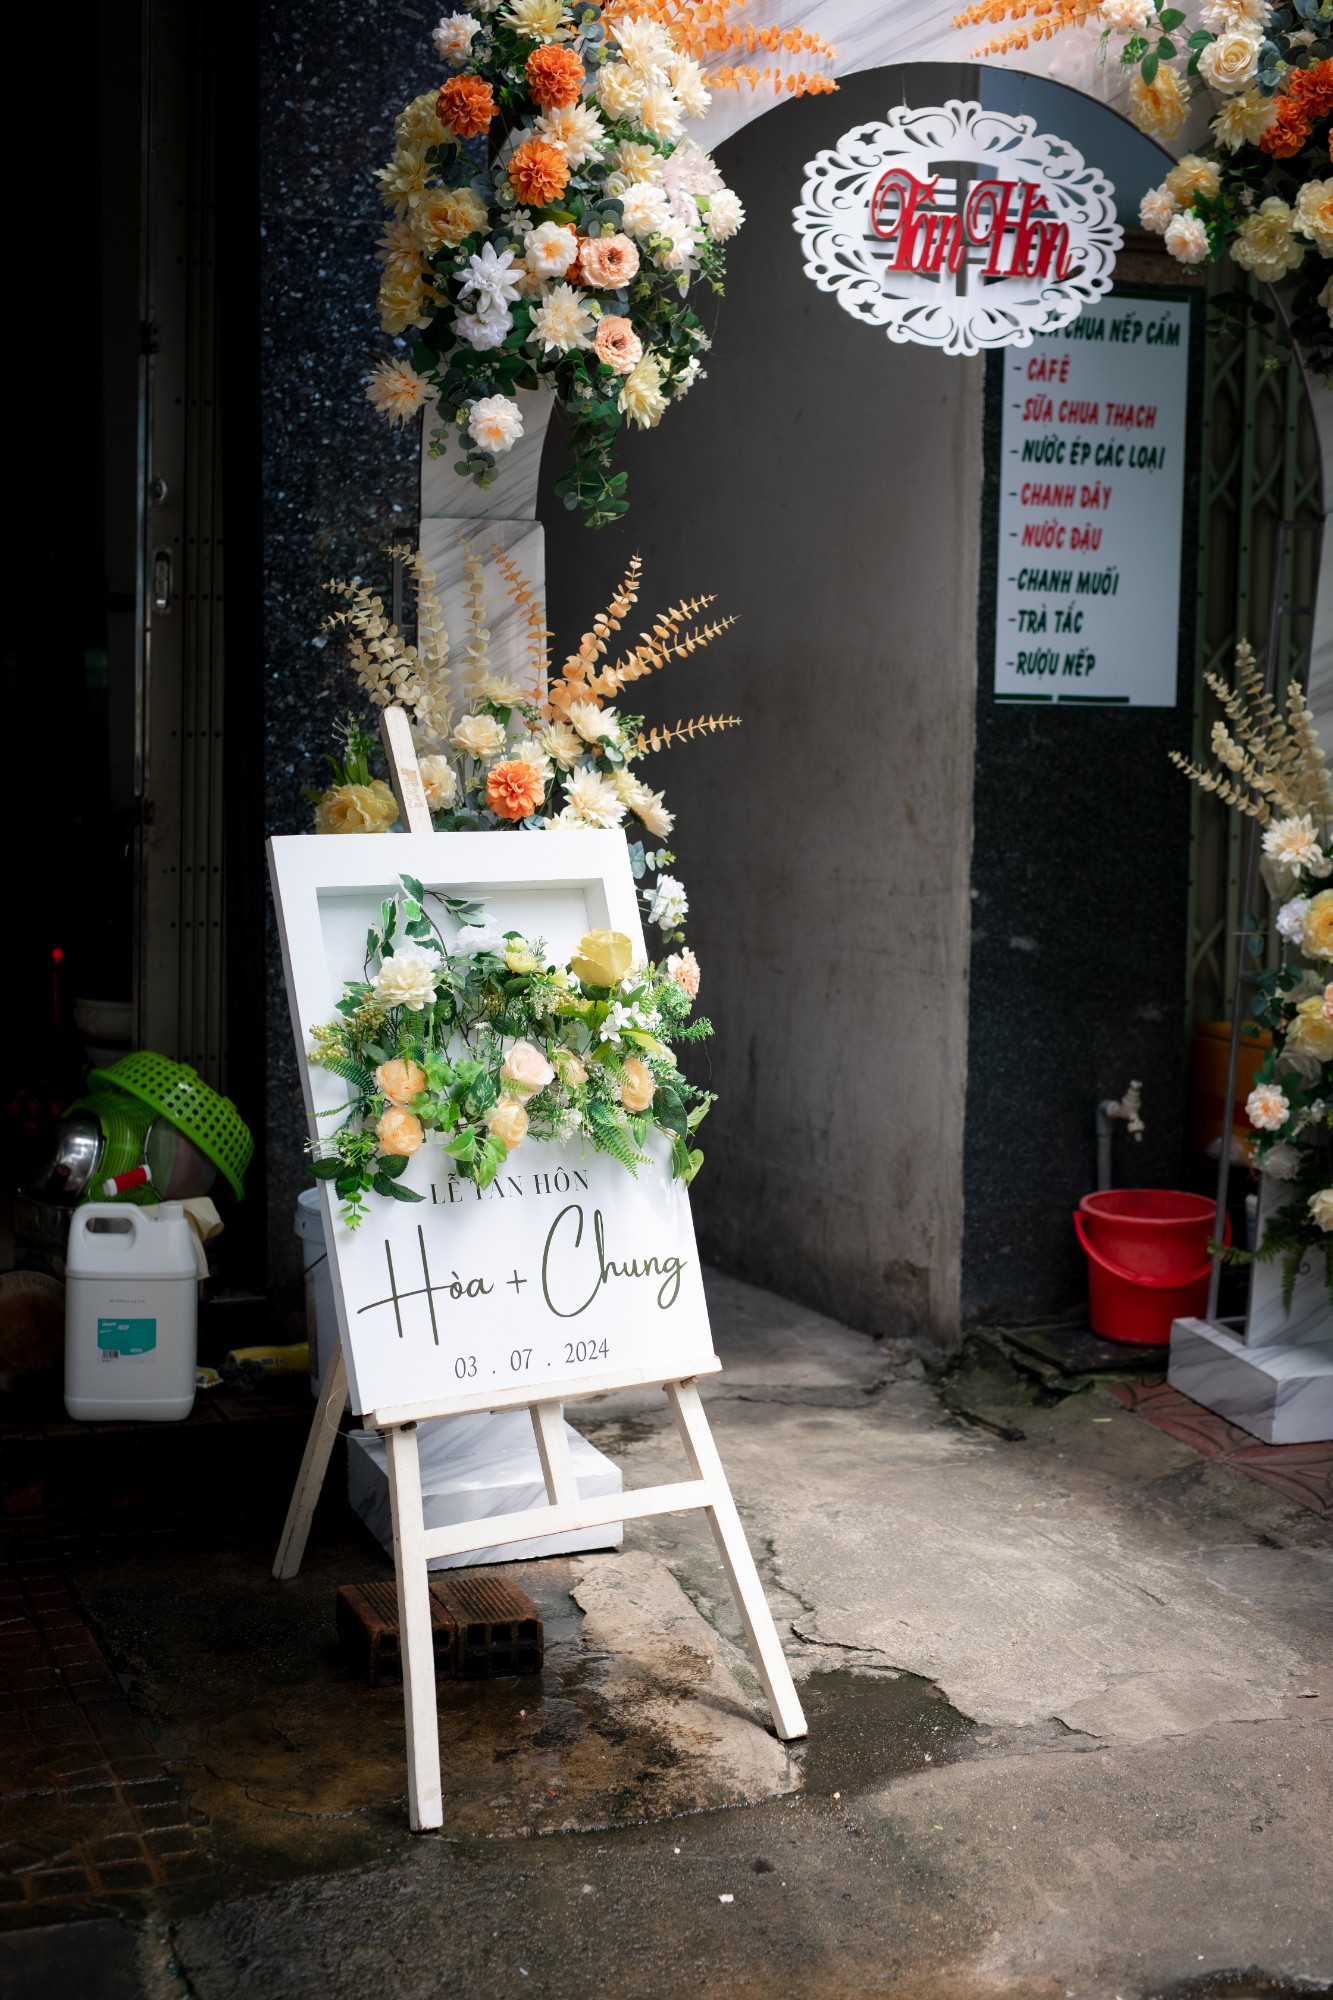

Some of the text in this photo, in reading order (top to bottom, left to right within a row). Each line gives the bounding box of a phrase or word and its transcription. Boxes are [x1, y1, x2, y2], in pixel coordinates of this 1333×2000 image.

[1065, 316, 1105, 341] CHUA
[1109, 311, 1143, 343] NẾP
[1058, 400, 1099, 425] CHUA
[1105, 403, 1157, 431] THẠCH
[1070, 436, 1091, 465] ÉP
[1095, 438, 1126, 467] CÁC
[1129, 446, 1166, 473] LOẠI
[1020, 482, 1076, 507] CHANH
[1017, 566, 1120, 595] CHANH MUỐI
[1018, 603, 1047, 634] TRÀ
[1063, 647, 1095, 676] NẾP
[429, 1173, 463, 1204] LỄ
[533, 1166, 589, 1194] HÔN
[357, 1204, 687, 1346] Hòa + Chung
[454, 1356, 478, 1379] 03
[510, 1348, 533, 1371] 07
[564, 1338, 610, 1364] 2024
